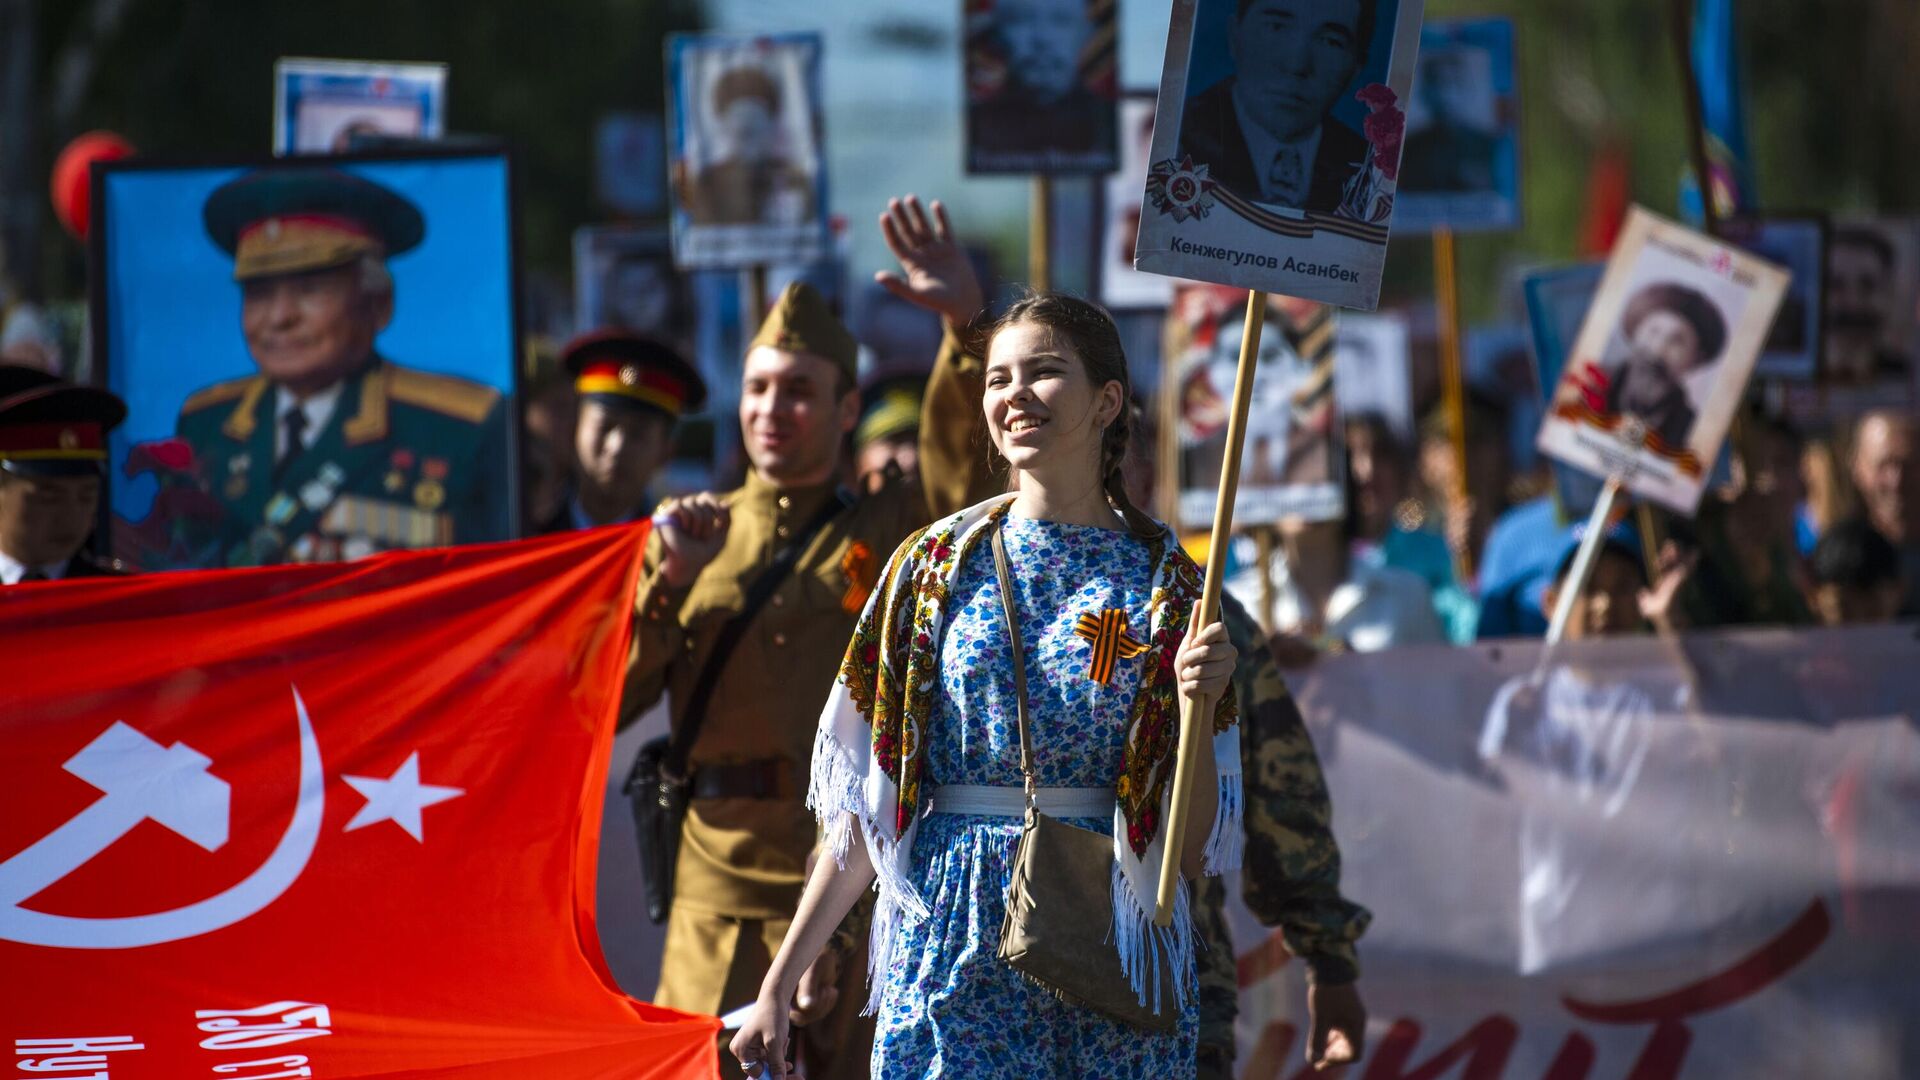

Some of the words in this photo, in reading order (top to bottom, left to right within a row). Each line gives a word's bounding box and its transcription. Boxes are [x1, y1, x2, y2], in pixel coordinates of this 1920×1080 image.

[1170, 236, 1278, 269] Кенжегулов
[1282, 256, 1360, 283] Асанбек
[195, 1000, 332, 1050] 150
